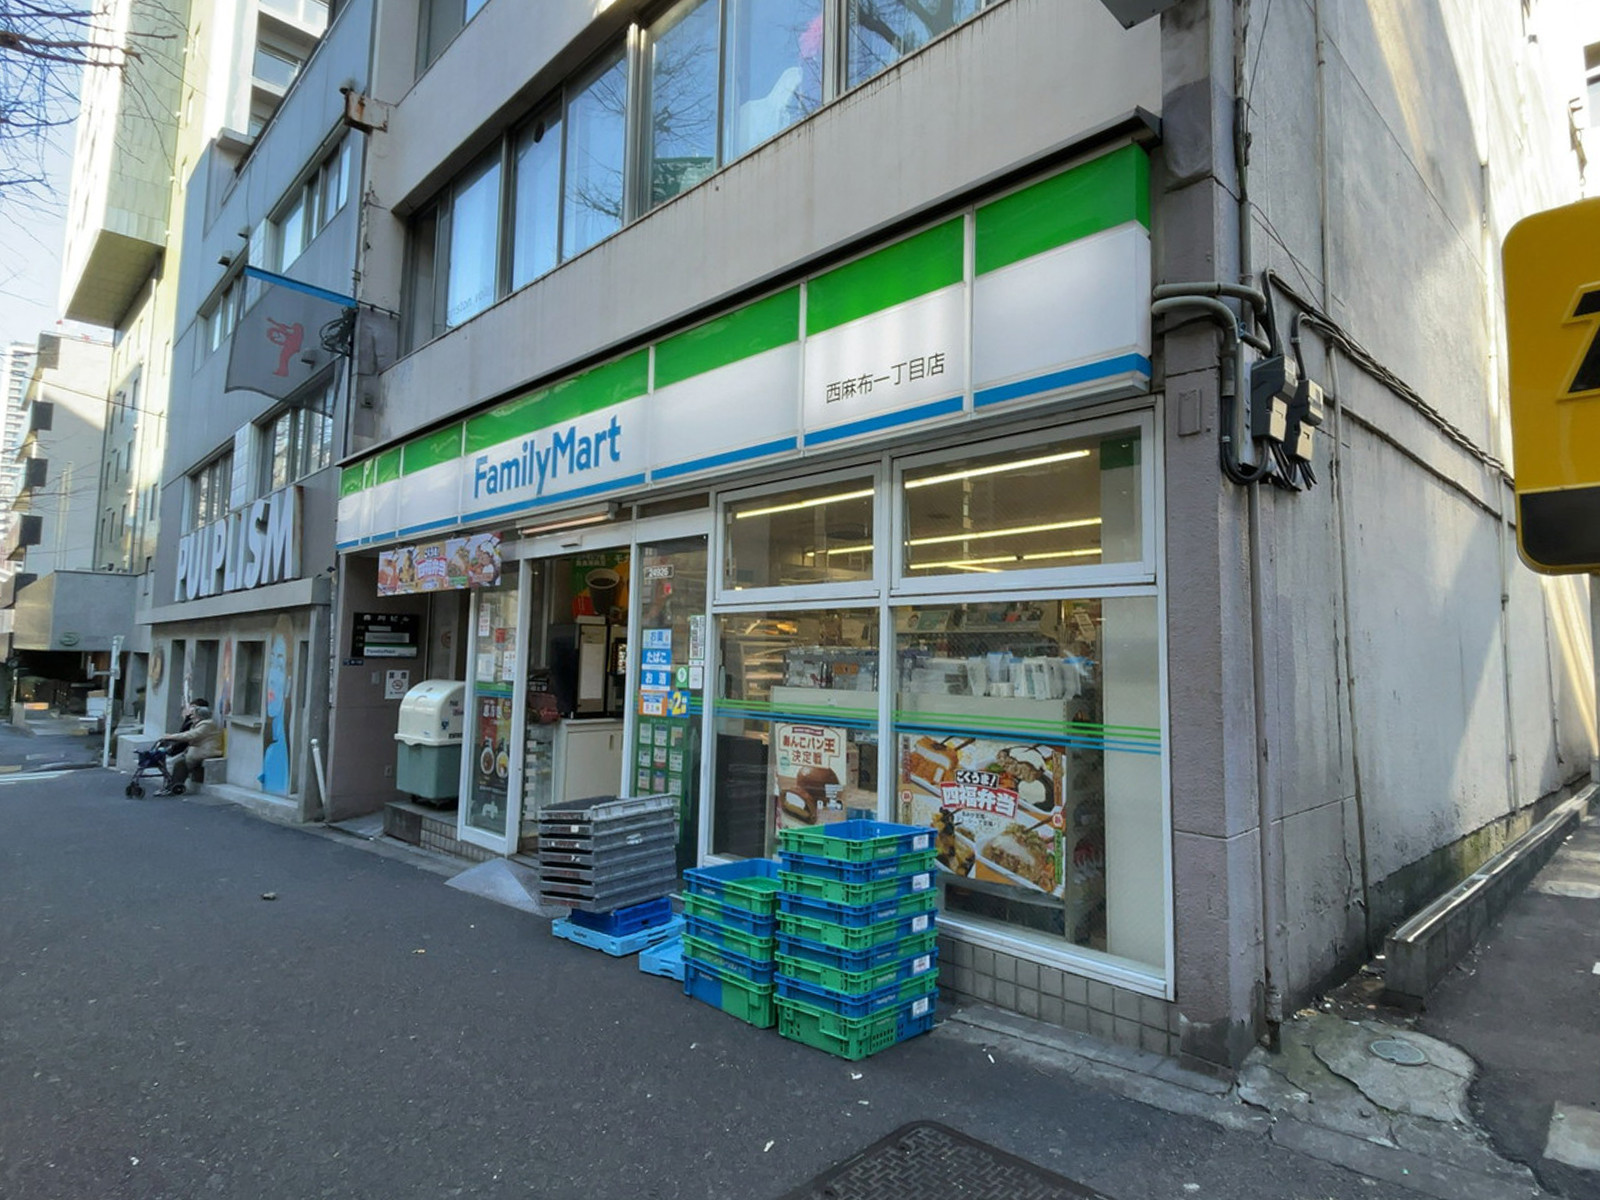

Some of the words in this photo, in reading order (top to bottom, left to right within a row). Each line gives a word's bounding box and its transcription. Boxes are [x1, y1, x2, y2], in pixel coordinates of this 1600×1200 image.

[826, 352, 945, 404] 西麻布一丁目店
[474, 414, 621, 499] FamilyMart
[174, 485, 298, 602] PULPLISM
[942, 785, 1015, 818] 四福弁当
